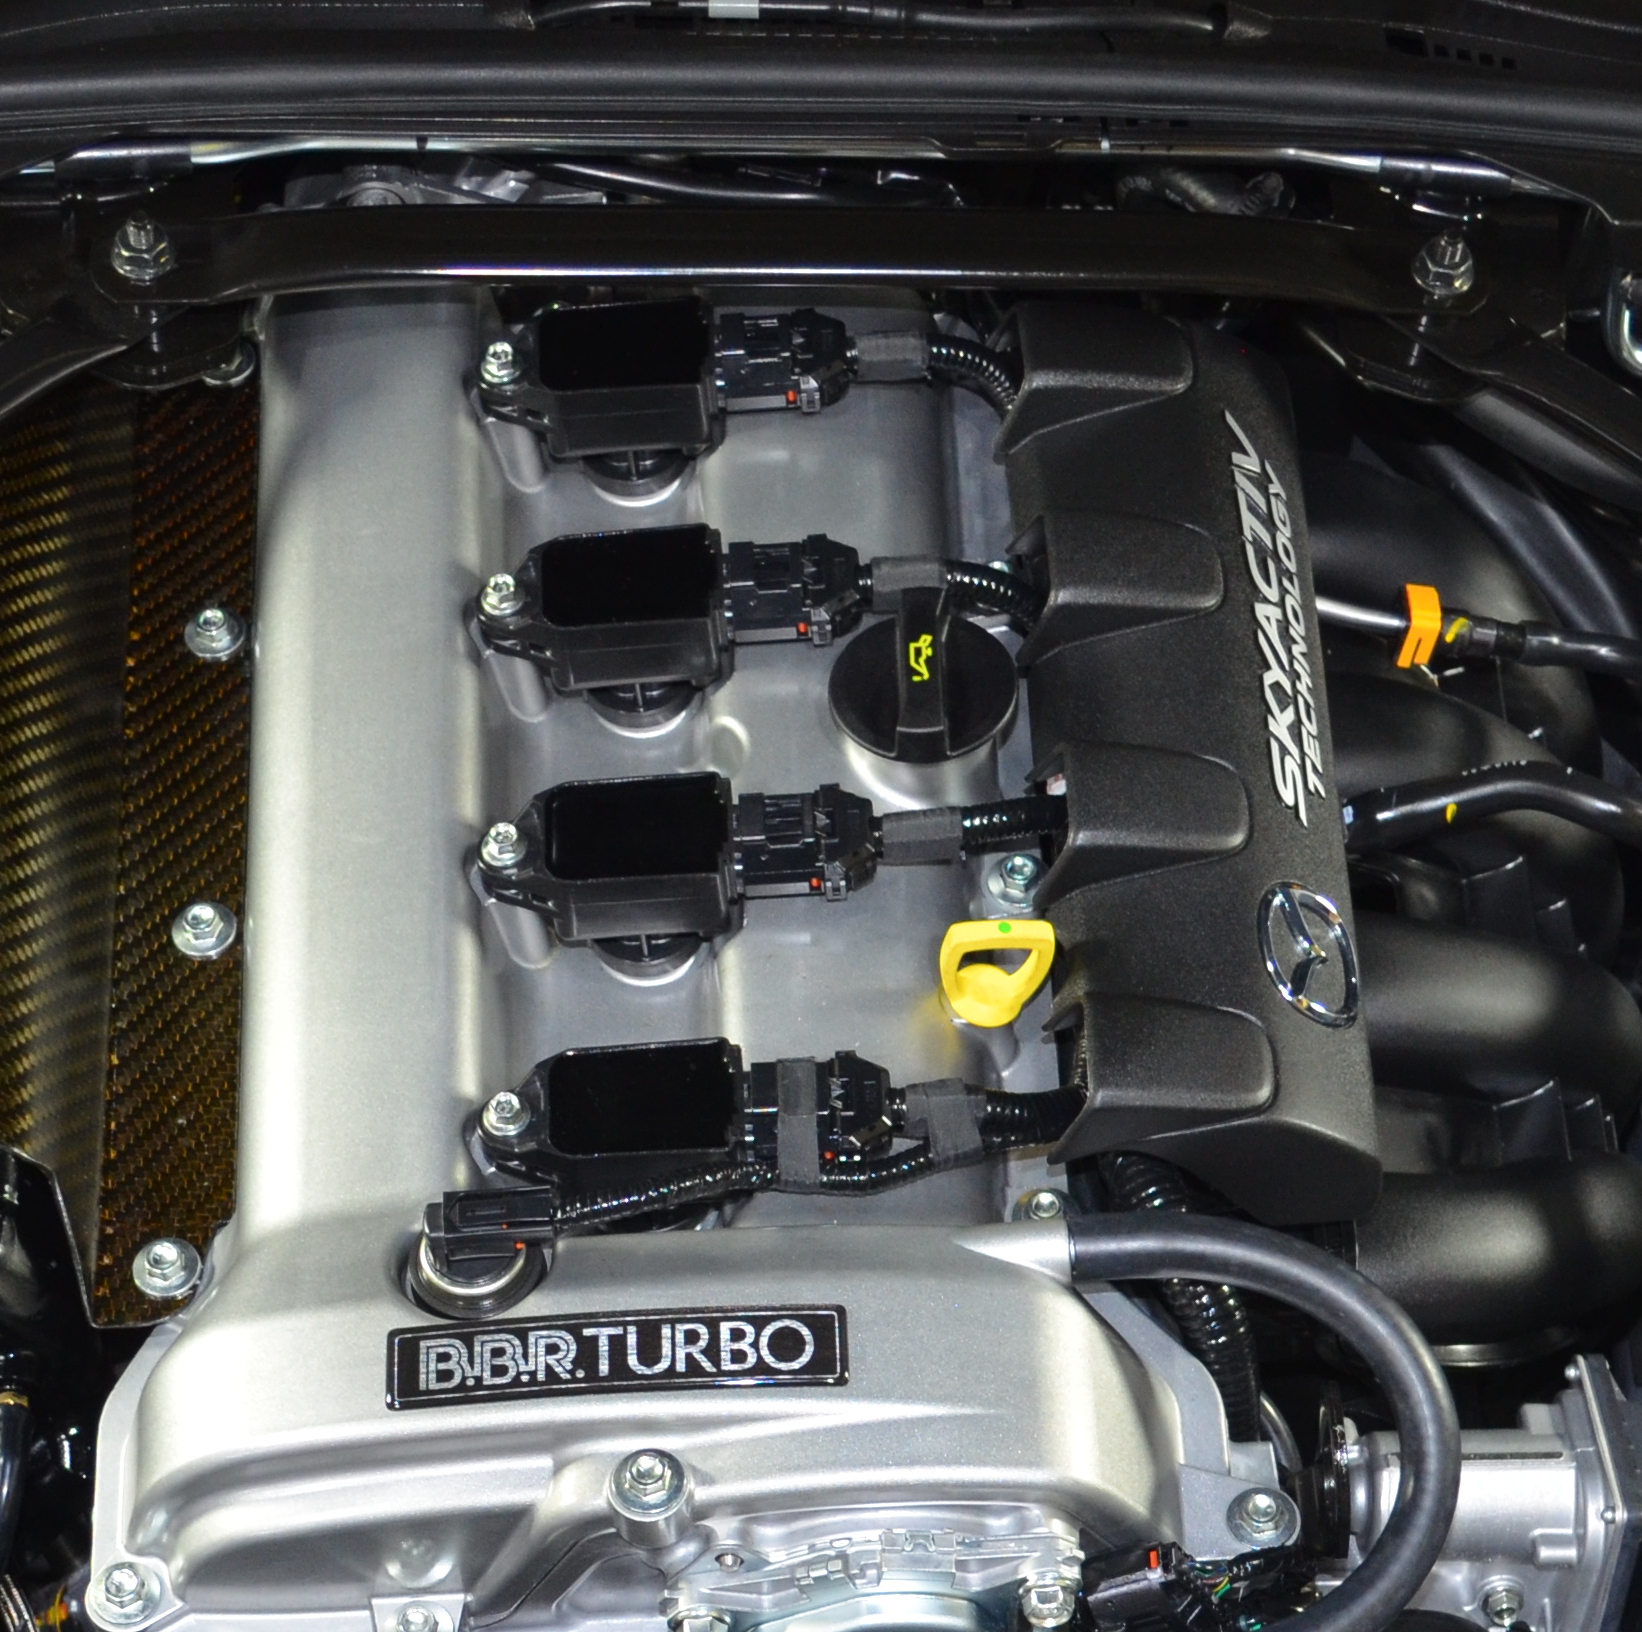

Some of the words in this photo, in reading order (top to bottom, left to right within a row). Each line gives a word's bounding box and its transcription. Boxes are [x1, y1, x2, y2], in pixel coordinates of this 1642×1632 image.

[1224, 409, 1307, 827] SKYACTIV
[1264, 460, 1326, 799] TECHNOLOGY
[583, 1318, 815, 1377] TURBO
